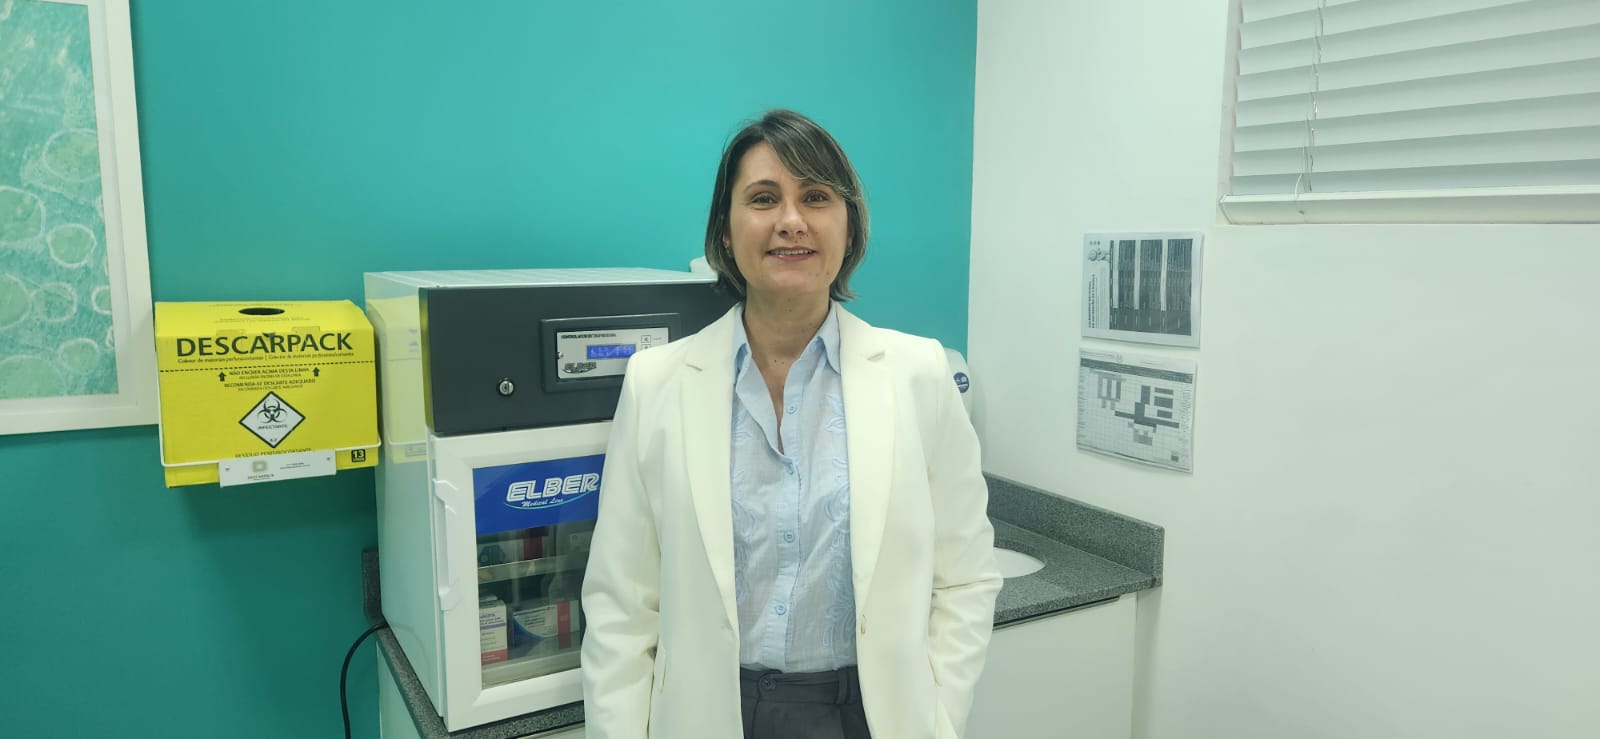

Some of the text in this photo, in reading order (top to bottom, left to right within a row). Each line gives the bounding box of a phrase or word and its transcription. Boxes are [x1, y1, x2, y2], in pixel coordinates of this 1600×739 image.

[176, 332, 353, 357] DESCARPACK
[352, 450, 365, 458] 13
[506, 473, 600, 502] ELBER
[521, 499, 548, 507] Medical
